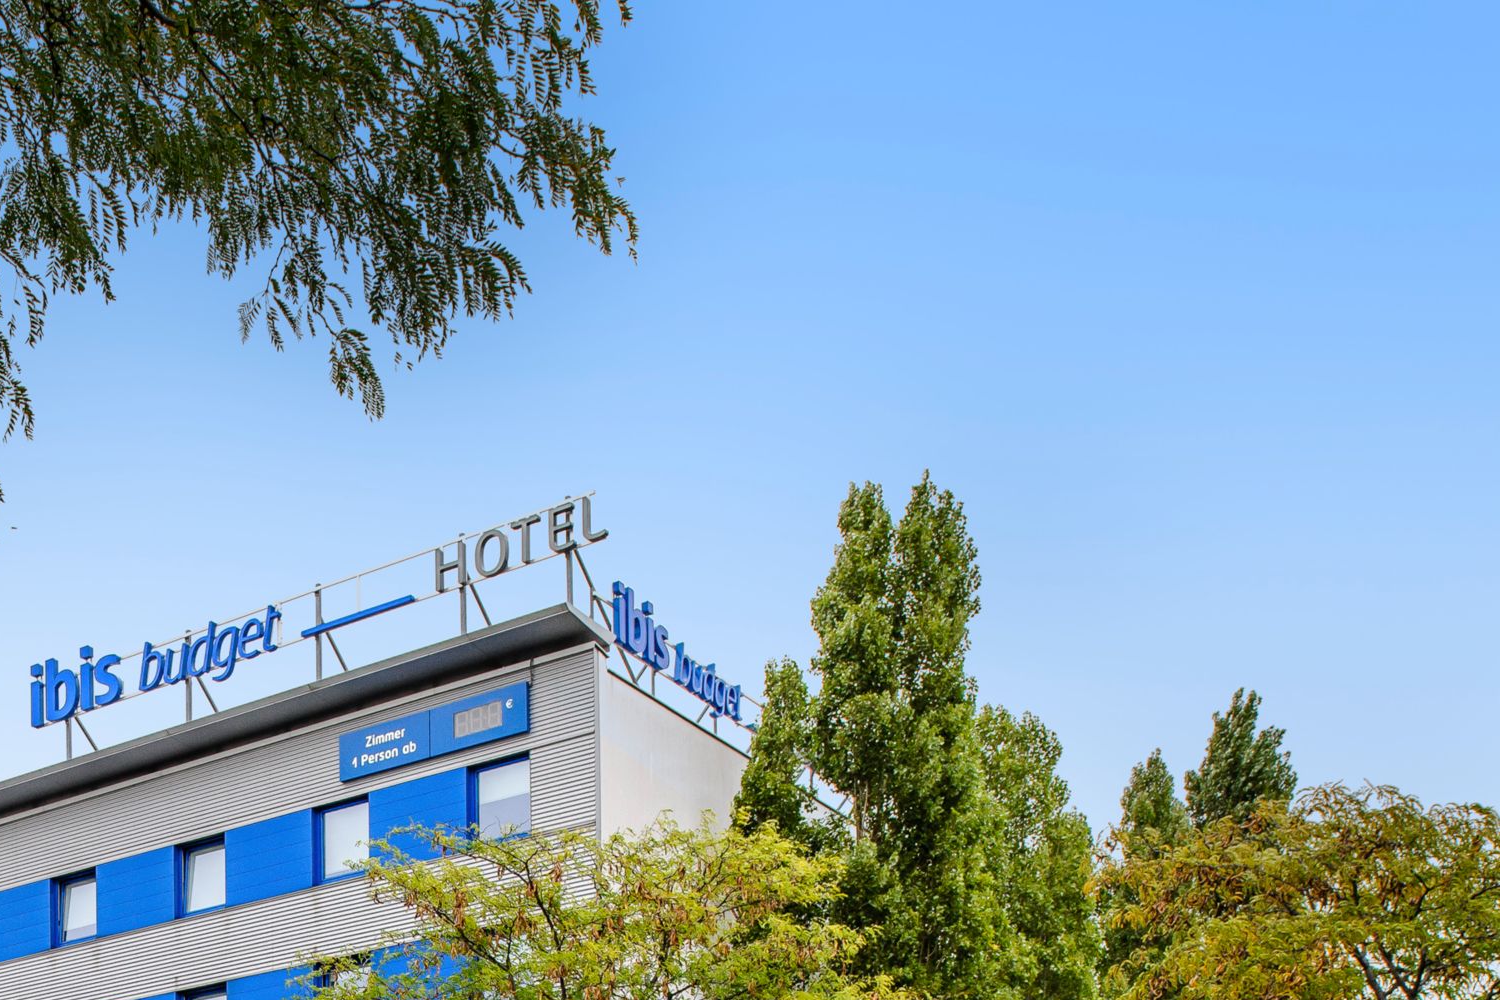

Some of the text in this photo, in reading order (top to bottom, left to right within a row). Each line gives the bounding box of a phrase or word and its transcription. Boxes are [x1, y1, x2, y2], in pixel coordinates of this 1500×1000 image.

[435, 496, 609, 593] HOTEL
[30, 605, 282, 729] ibis budget
[612, 580, 742, 722] ibis budget
[352, 741, 416, 768] 1 Person ab
[365, 728, 405, 748] Zimmer
